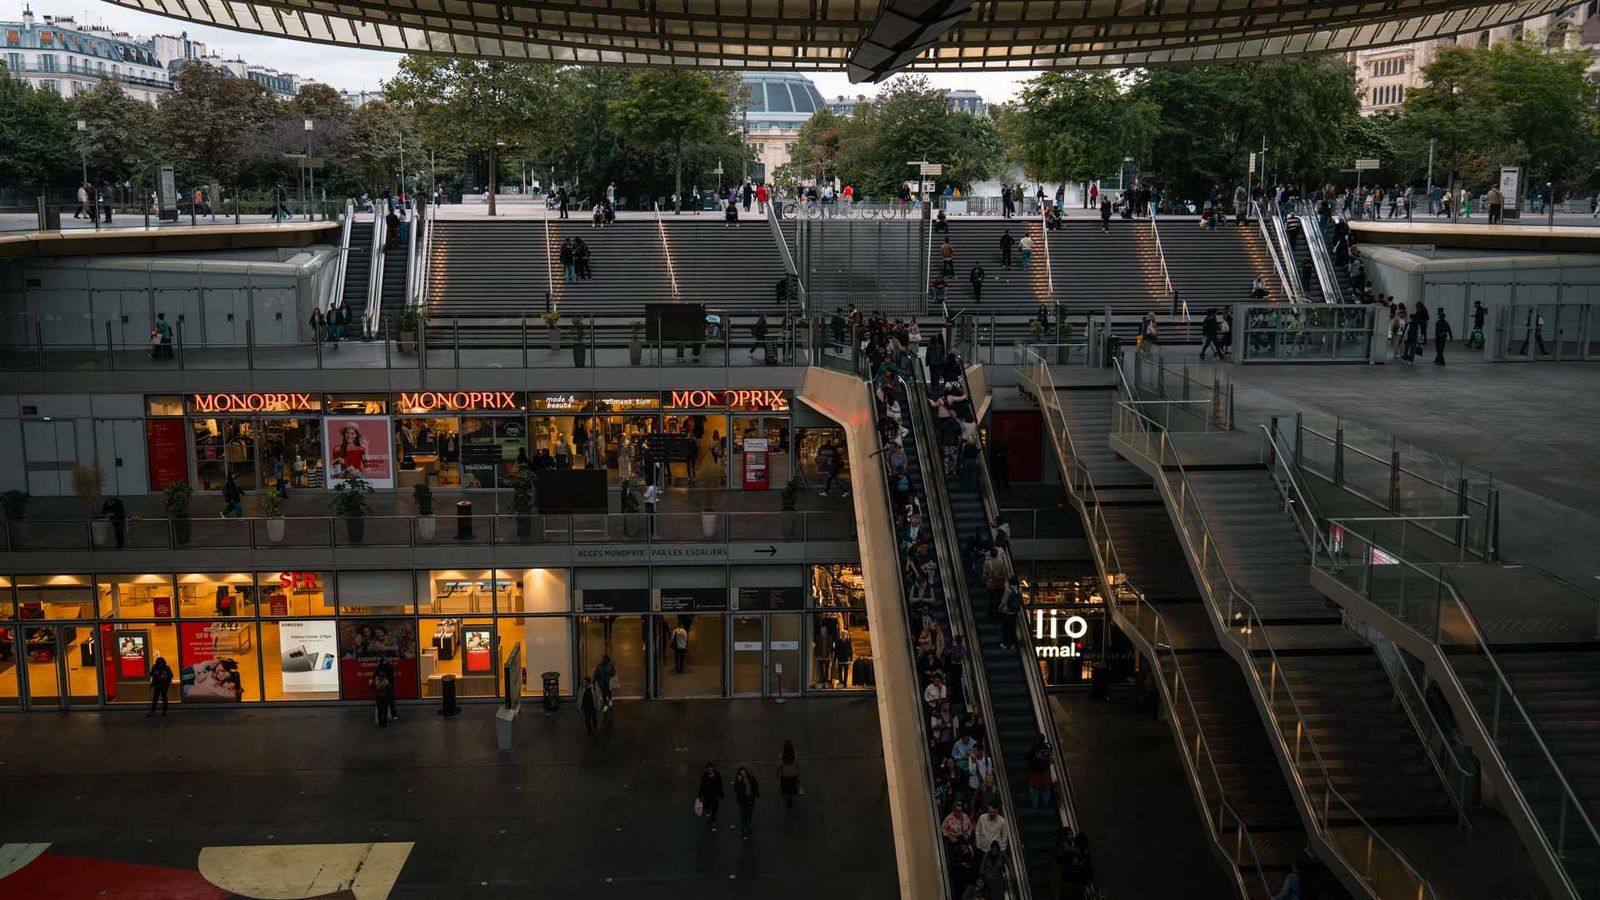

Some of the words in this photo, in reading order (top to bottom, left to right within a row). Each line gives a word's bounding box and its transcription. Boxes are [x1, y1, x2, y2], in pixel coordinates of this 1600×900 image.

[194, 393, 312, 411] MONOPRIX
[401, 392, 516, 409] MONOPRIX
[546, 395, 566, 403] mode
[604, 549, 644, 557] MONOPRIX
[686, 548, 728, 556] ESCALIERS
[280, 571, 317, 588] SFR
[1037, 609, 1088, 639] lio
